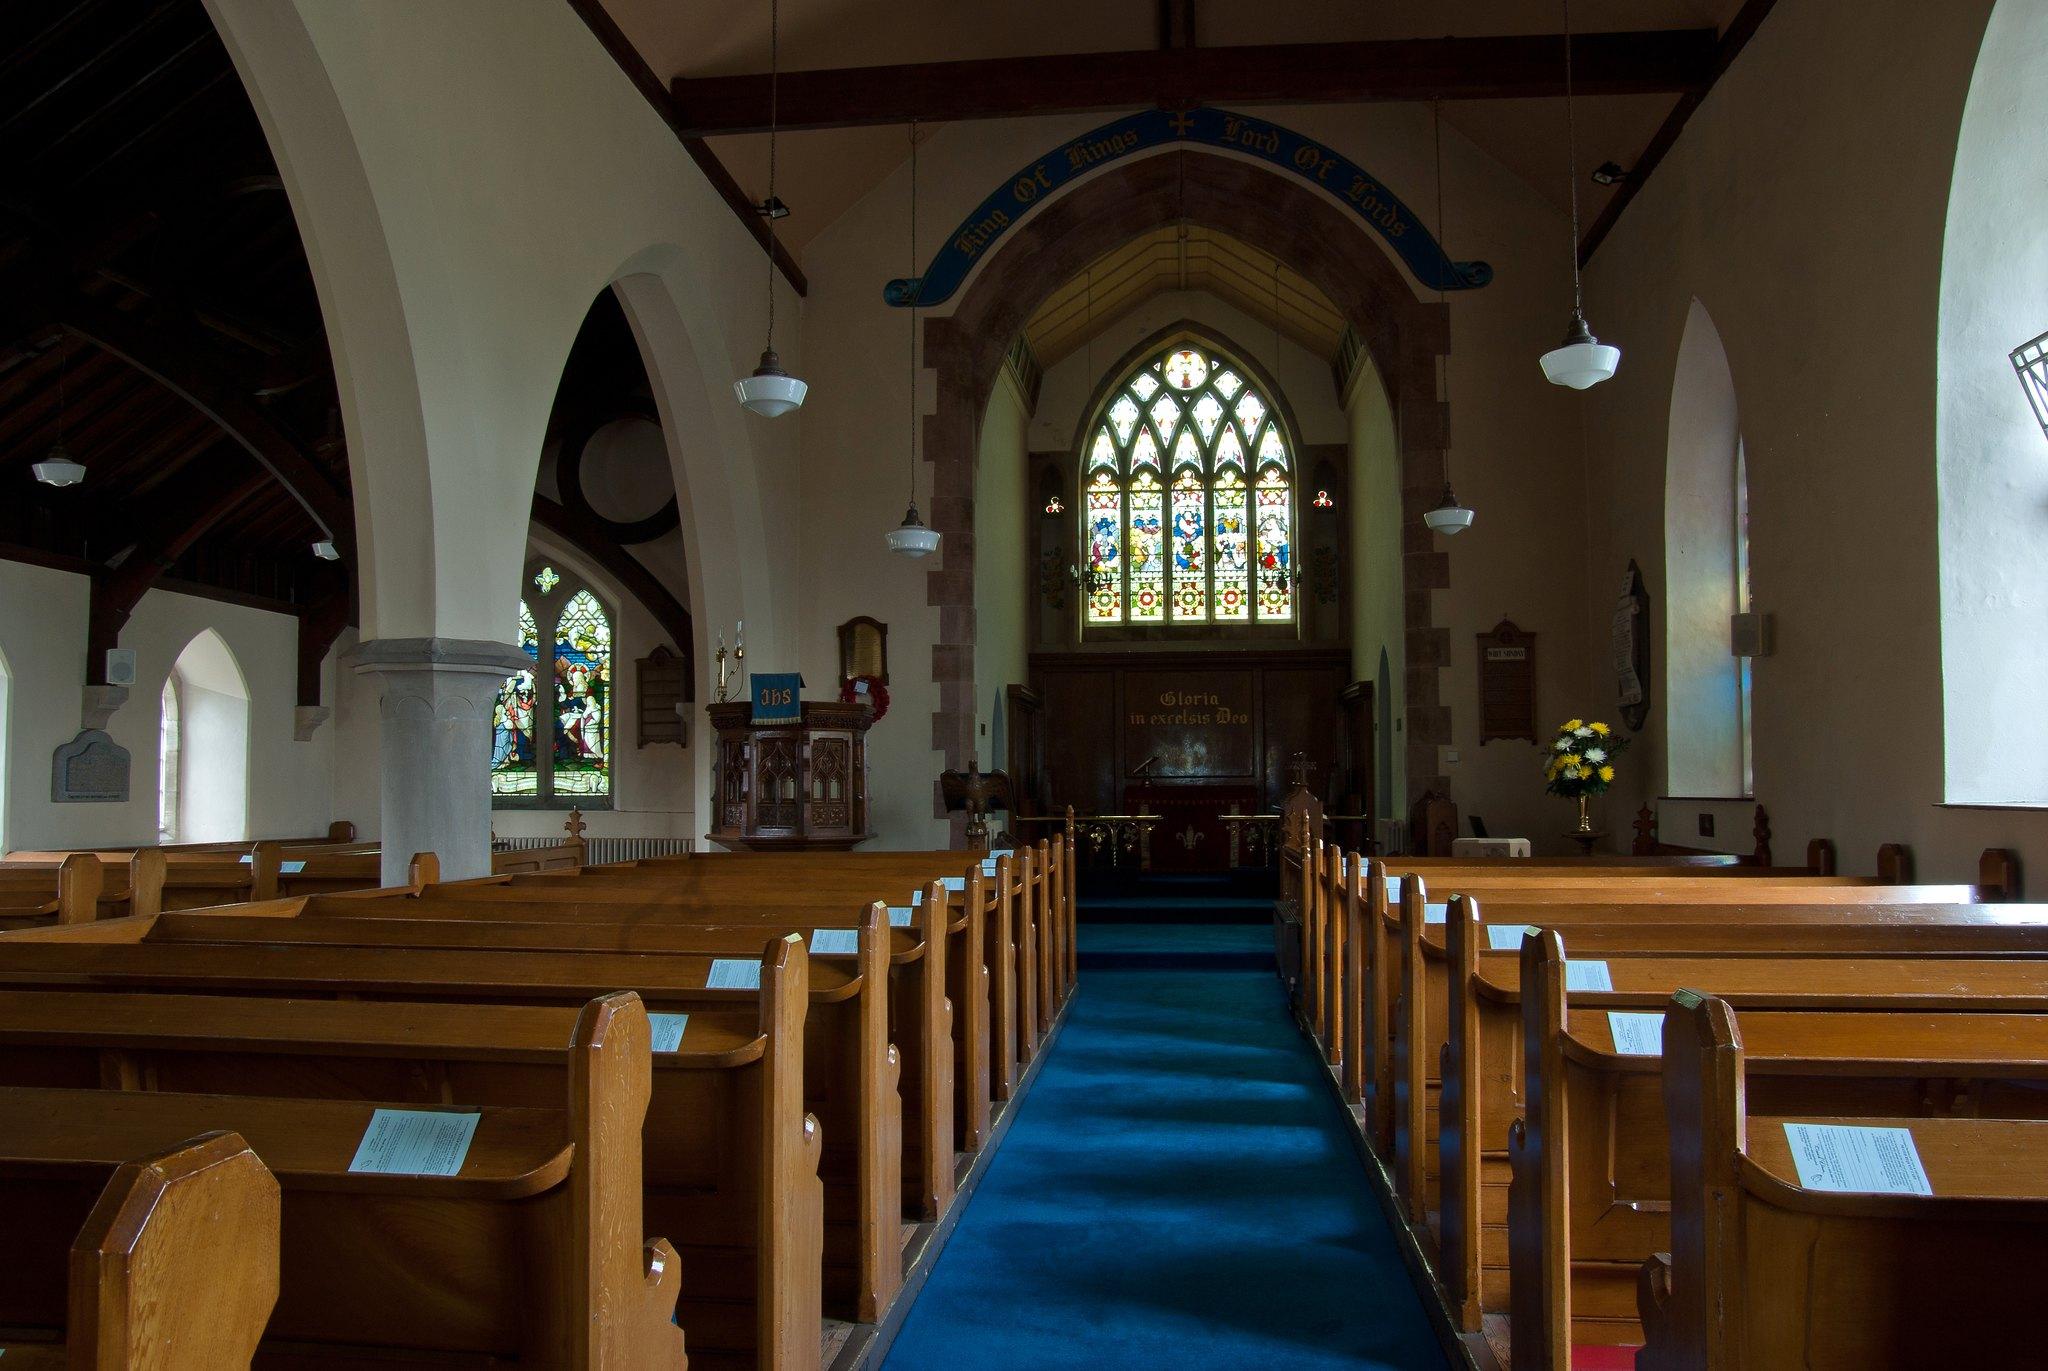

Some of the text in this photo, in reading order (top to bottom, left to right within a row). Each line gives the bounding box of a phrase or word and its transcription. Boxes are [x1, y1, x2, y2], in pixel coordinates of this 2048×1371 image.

[954, 129, 1139, 257] King Of Kings
[1220, 116, 1408, 237] Lord Of Lords
[1130, 706, 1249, 726] in excelsis Deo
[1160, 691, 1219, 706] Gloria
